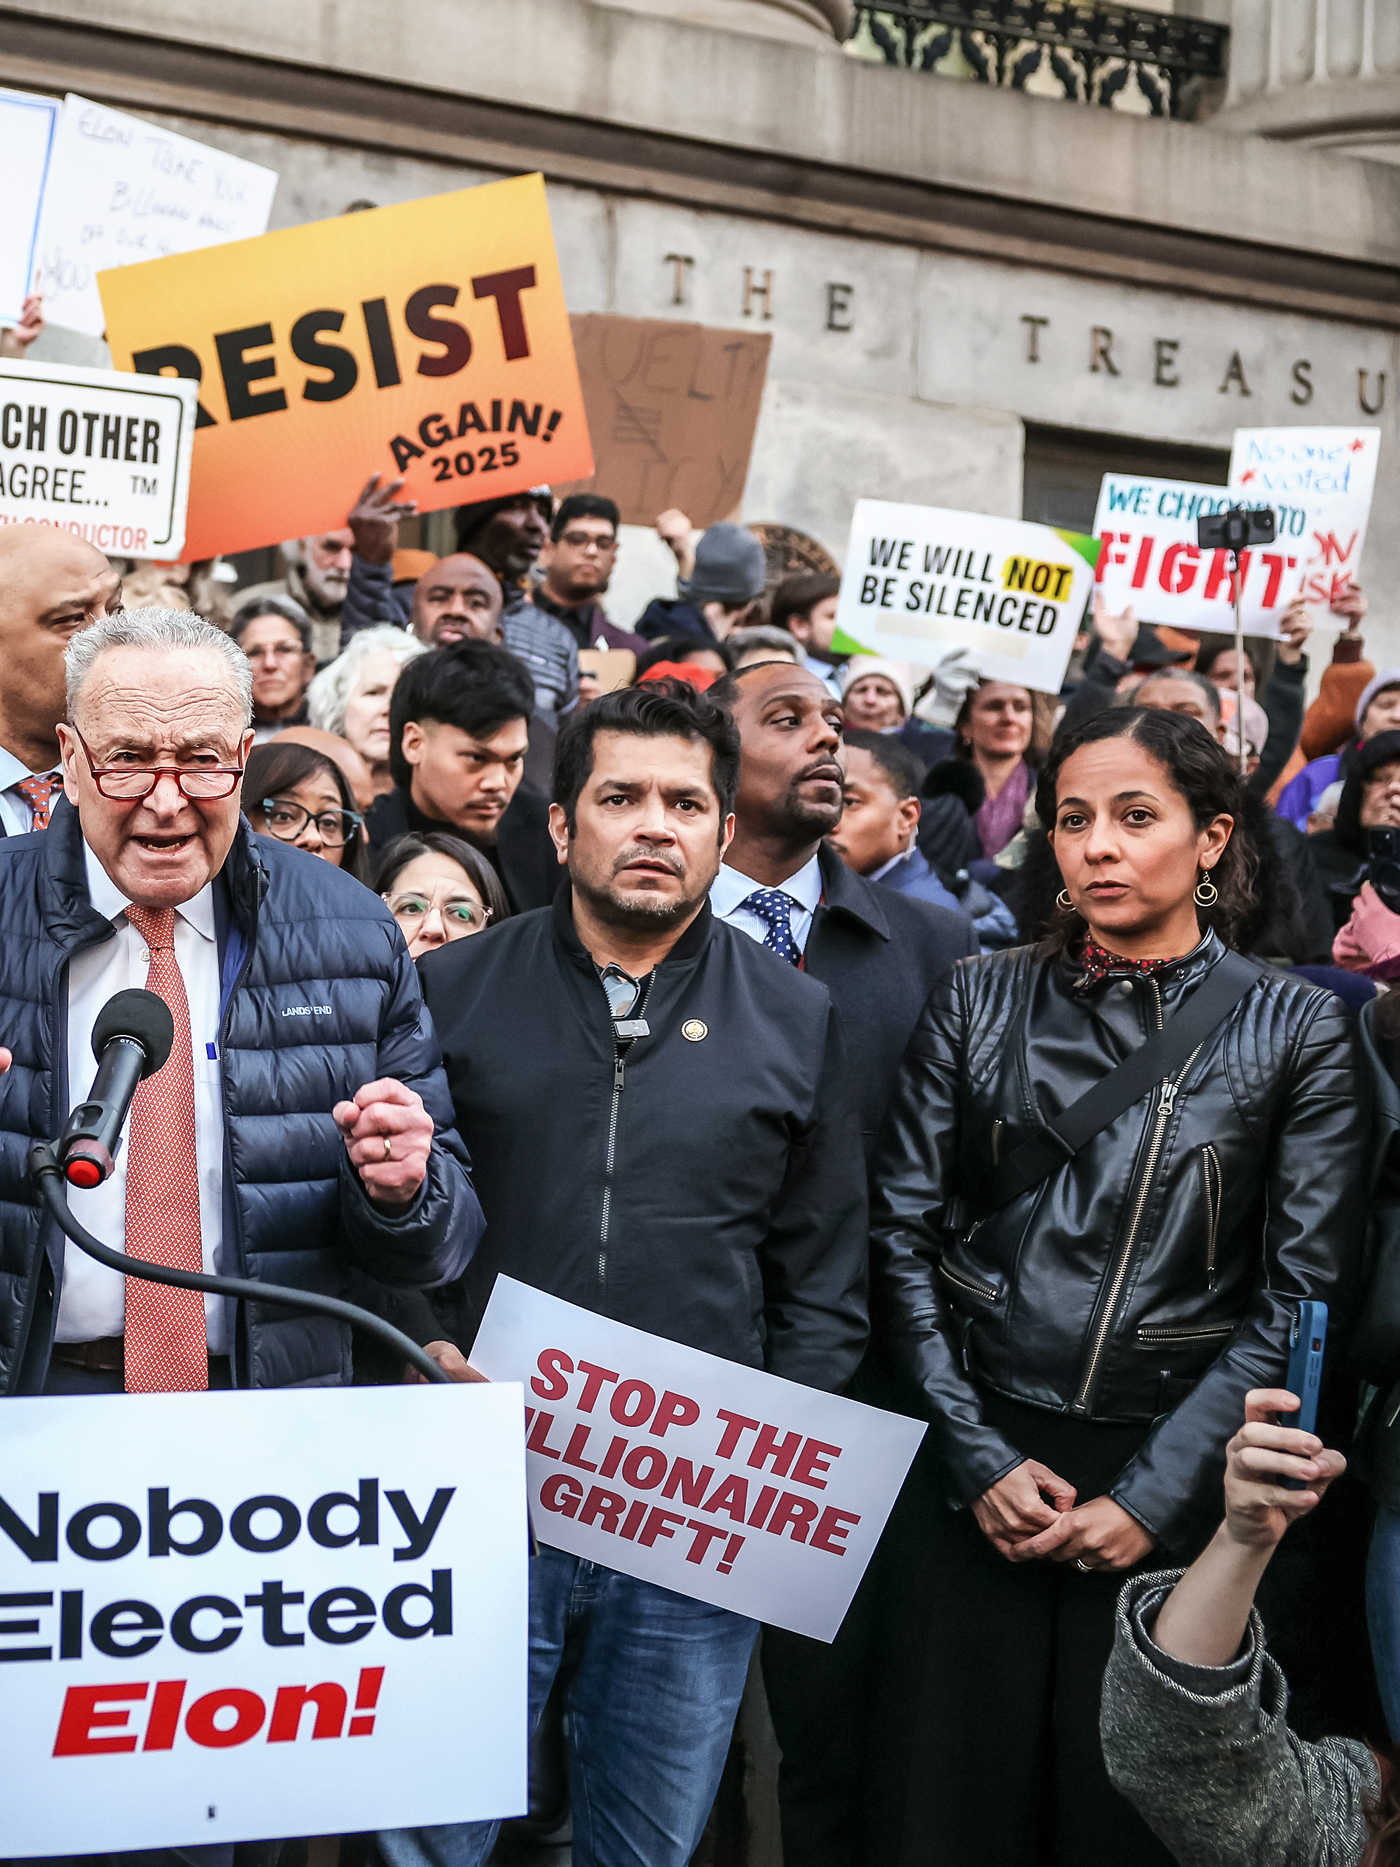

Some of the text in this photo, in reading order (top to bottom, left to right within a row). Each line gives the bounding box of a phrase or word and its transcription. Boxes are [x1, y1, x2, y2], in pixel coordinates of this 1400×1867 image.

[664, 253, 855, 332] THE
[57, 408, 160, 464] OTHER
[389, 398, 562, 474] AGAIN!
[432, 442, 520, 482] 2025
[1107, 483, 1151, 517] WE
[1278, 505, 1306, 537] TO
[869, 537, 1073, 598] WE WILL NOT
[1095, 531, 1298, 609] FIGHT
[860, 574, 1058, 635] BE SILENCED
[313, 1005, 332, 1015] END
[530, 1348, 843, 1490] STOP THE
[539, 1473, 746, 1575] GRIFT!
[52, 1665, 386, 1758] Elon!
